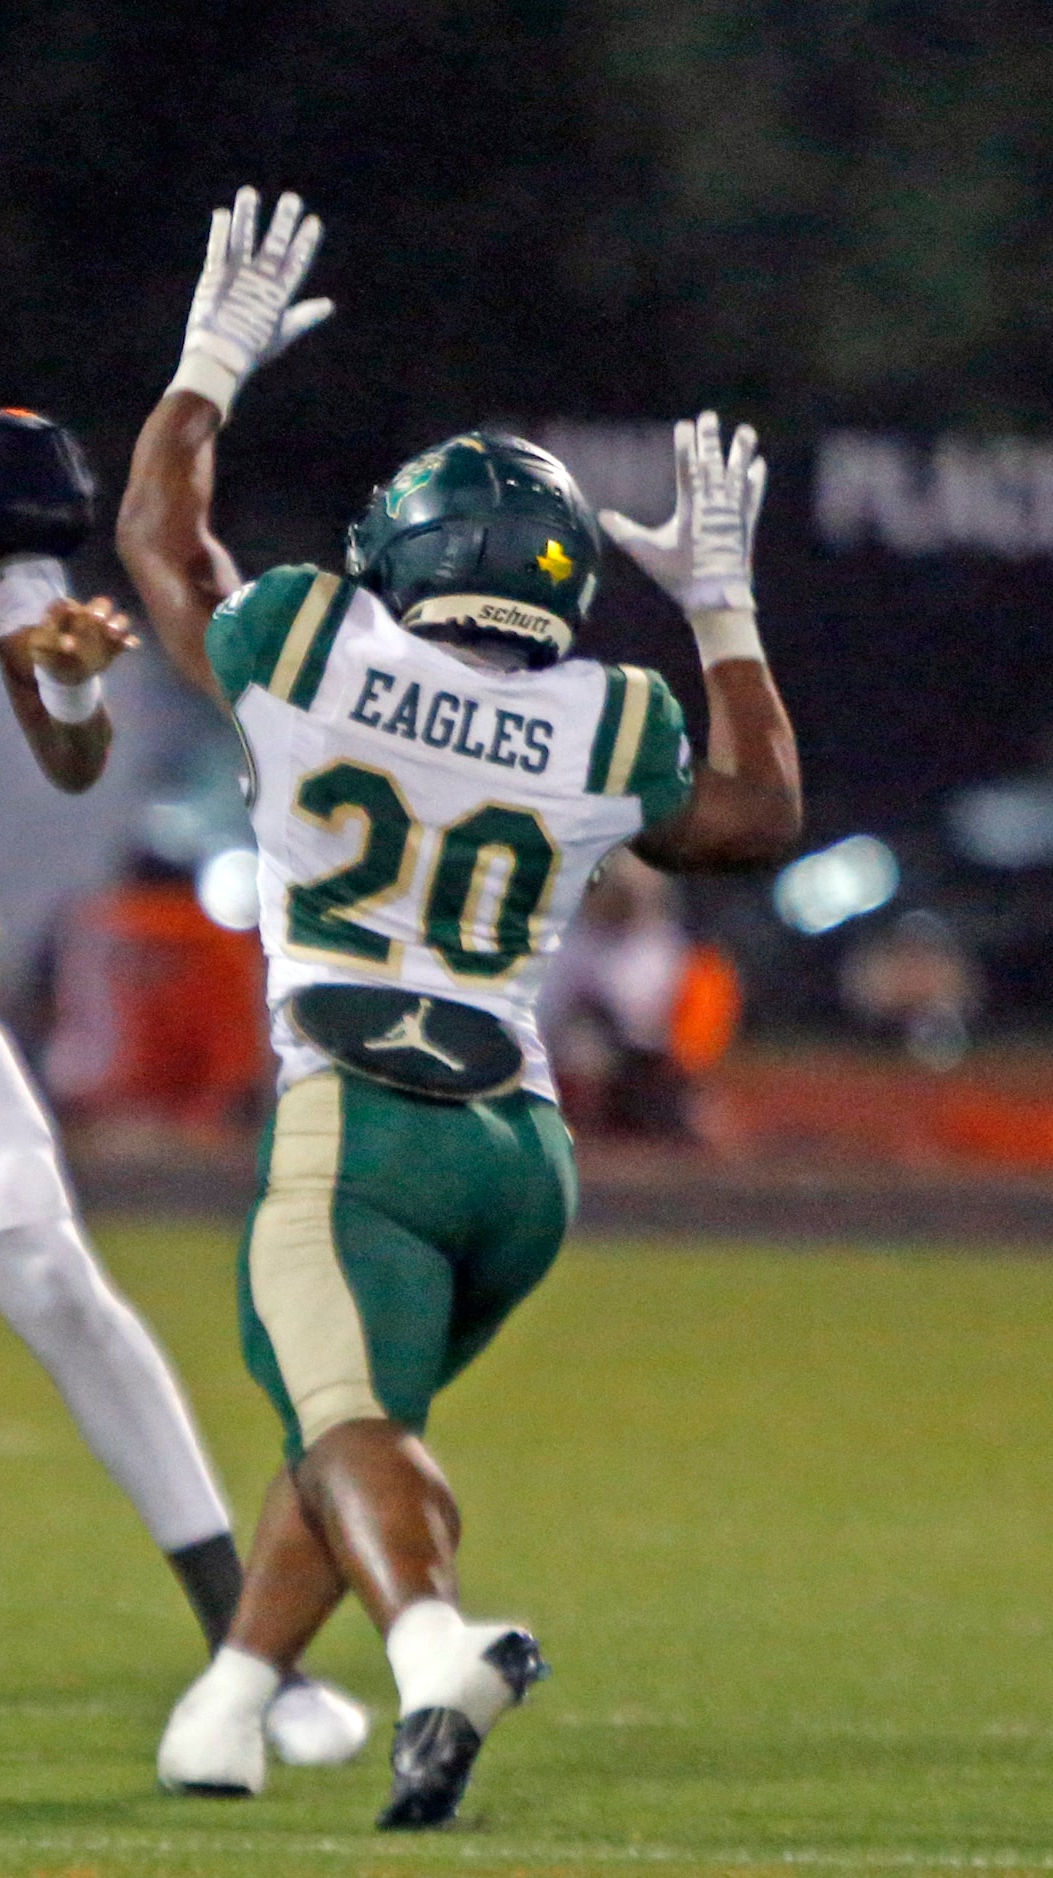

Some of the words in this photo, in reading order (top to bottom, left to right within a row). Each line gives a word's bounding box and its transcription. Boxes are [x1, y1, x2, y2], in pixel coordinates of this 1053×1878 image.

[478, 604, 550, 635] schutt
[349, 668, 554, 775] EAGLES
[285, 756, 562, 989] 20
